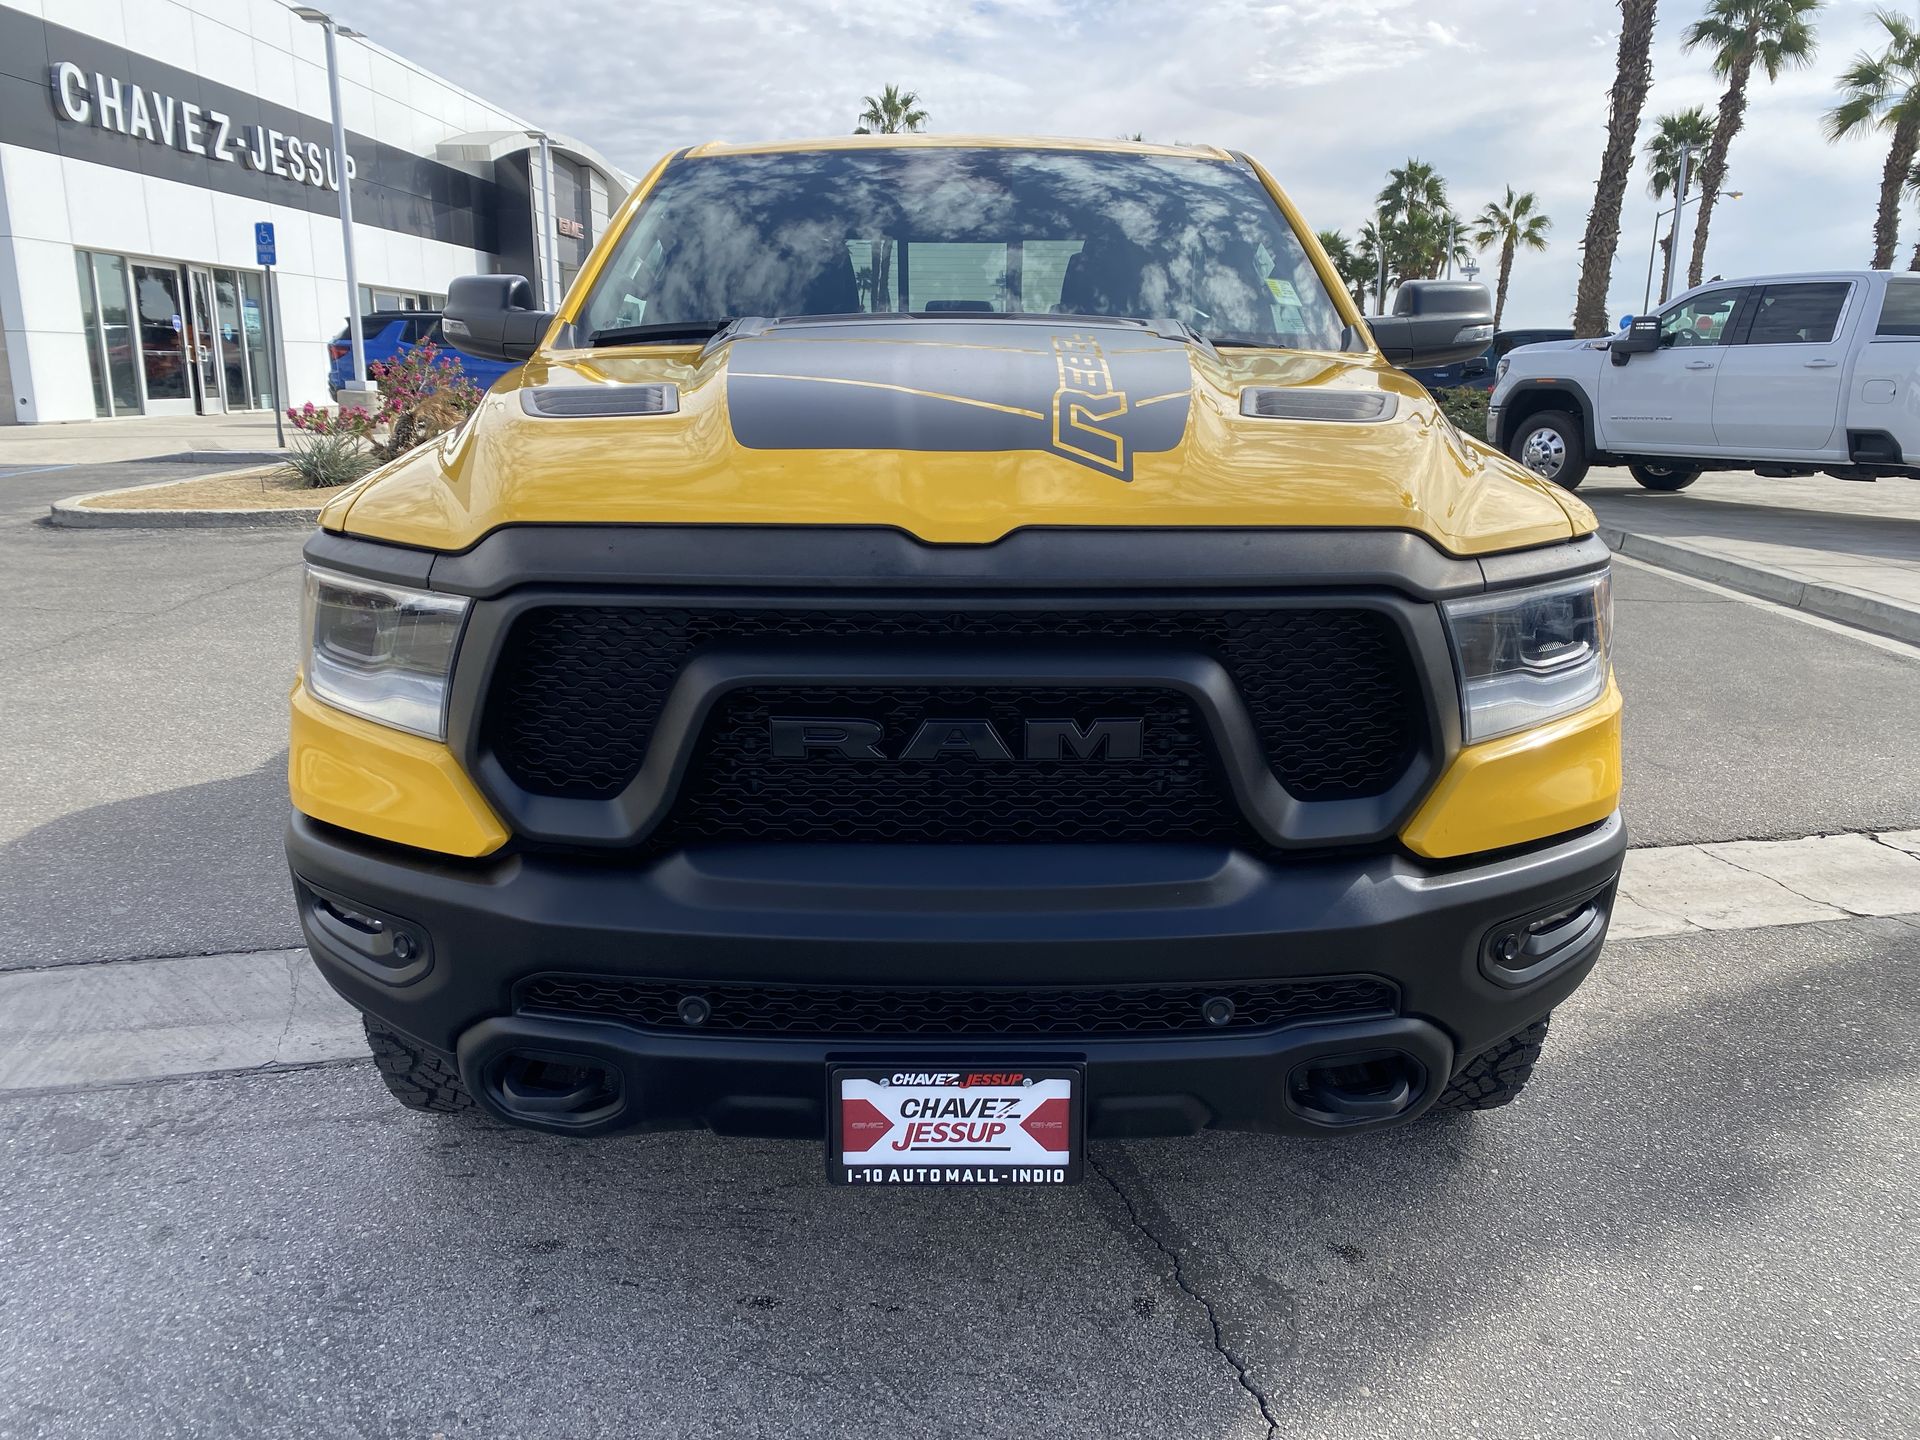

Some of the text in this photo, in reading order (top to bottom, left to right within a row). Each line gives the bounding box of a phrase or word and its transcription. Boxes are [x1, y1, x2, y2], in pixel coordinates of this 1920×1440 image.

[769, 715, 1145, 760] RAM
[892, 1073, 1023, 1089] CHAVEZ JESSUP
[900, 1098, 1022, 1119] CHAVEZ
[1030, 1121, 1063, 1129] GMC
[892, 1122, 1006, 1151] JESSUP
[847, 1168, 883, 1183] I-10
[888, 1168, 941, 1183] AUTO
